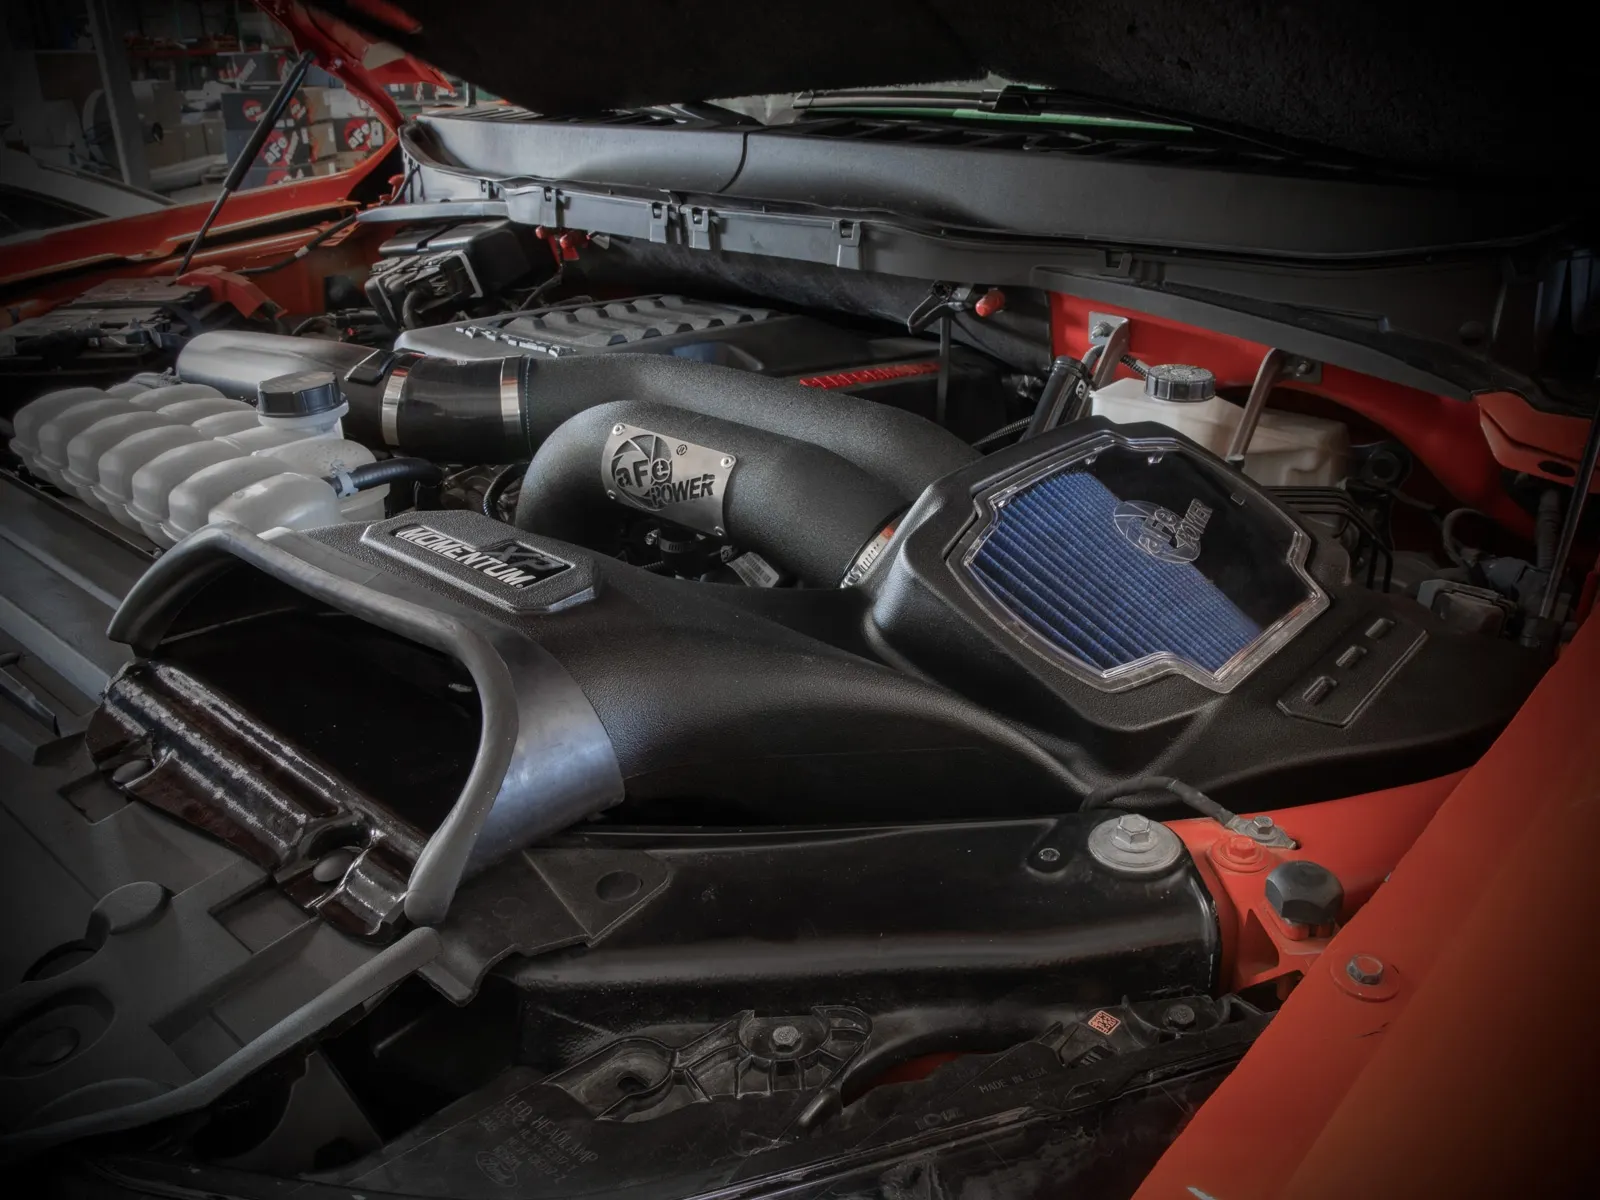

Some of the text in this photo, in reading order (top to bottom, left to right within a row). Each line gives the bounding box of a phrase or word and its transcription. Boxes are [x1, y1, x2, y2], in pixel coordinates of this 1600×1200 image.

[615, 458, 670, 488] aFe
[650, 474, 716, 507] POWER
[978, 1066, 1048, 1094] MADE IN USA
[503, 1094, 533, 1117] LED
[530, 1115, 599, 1164] HEADLAMP
